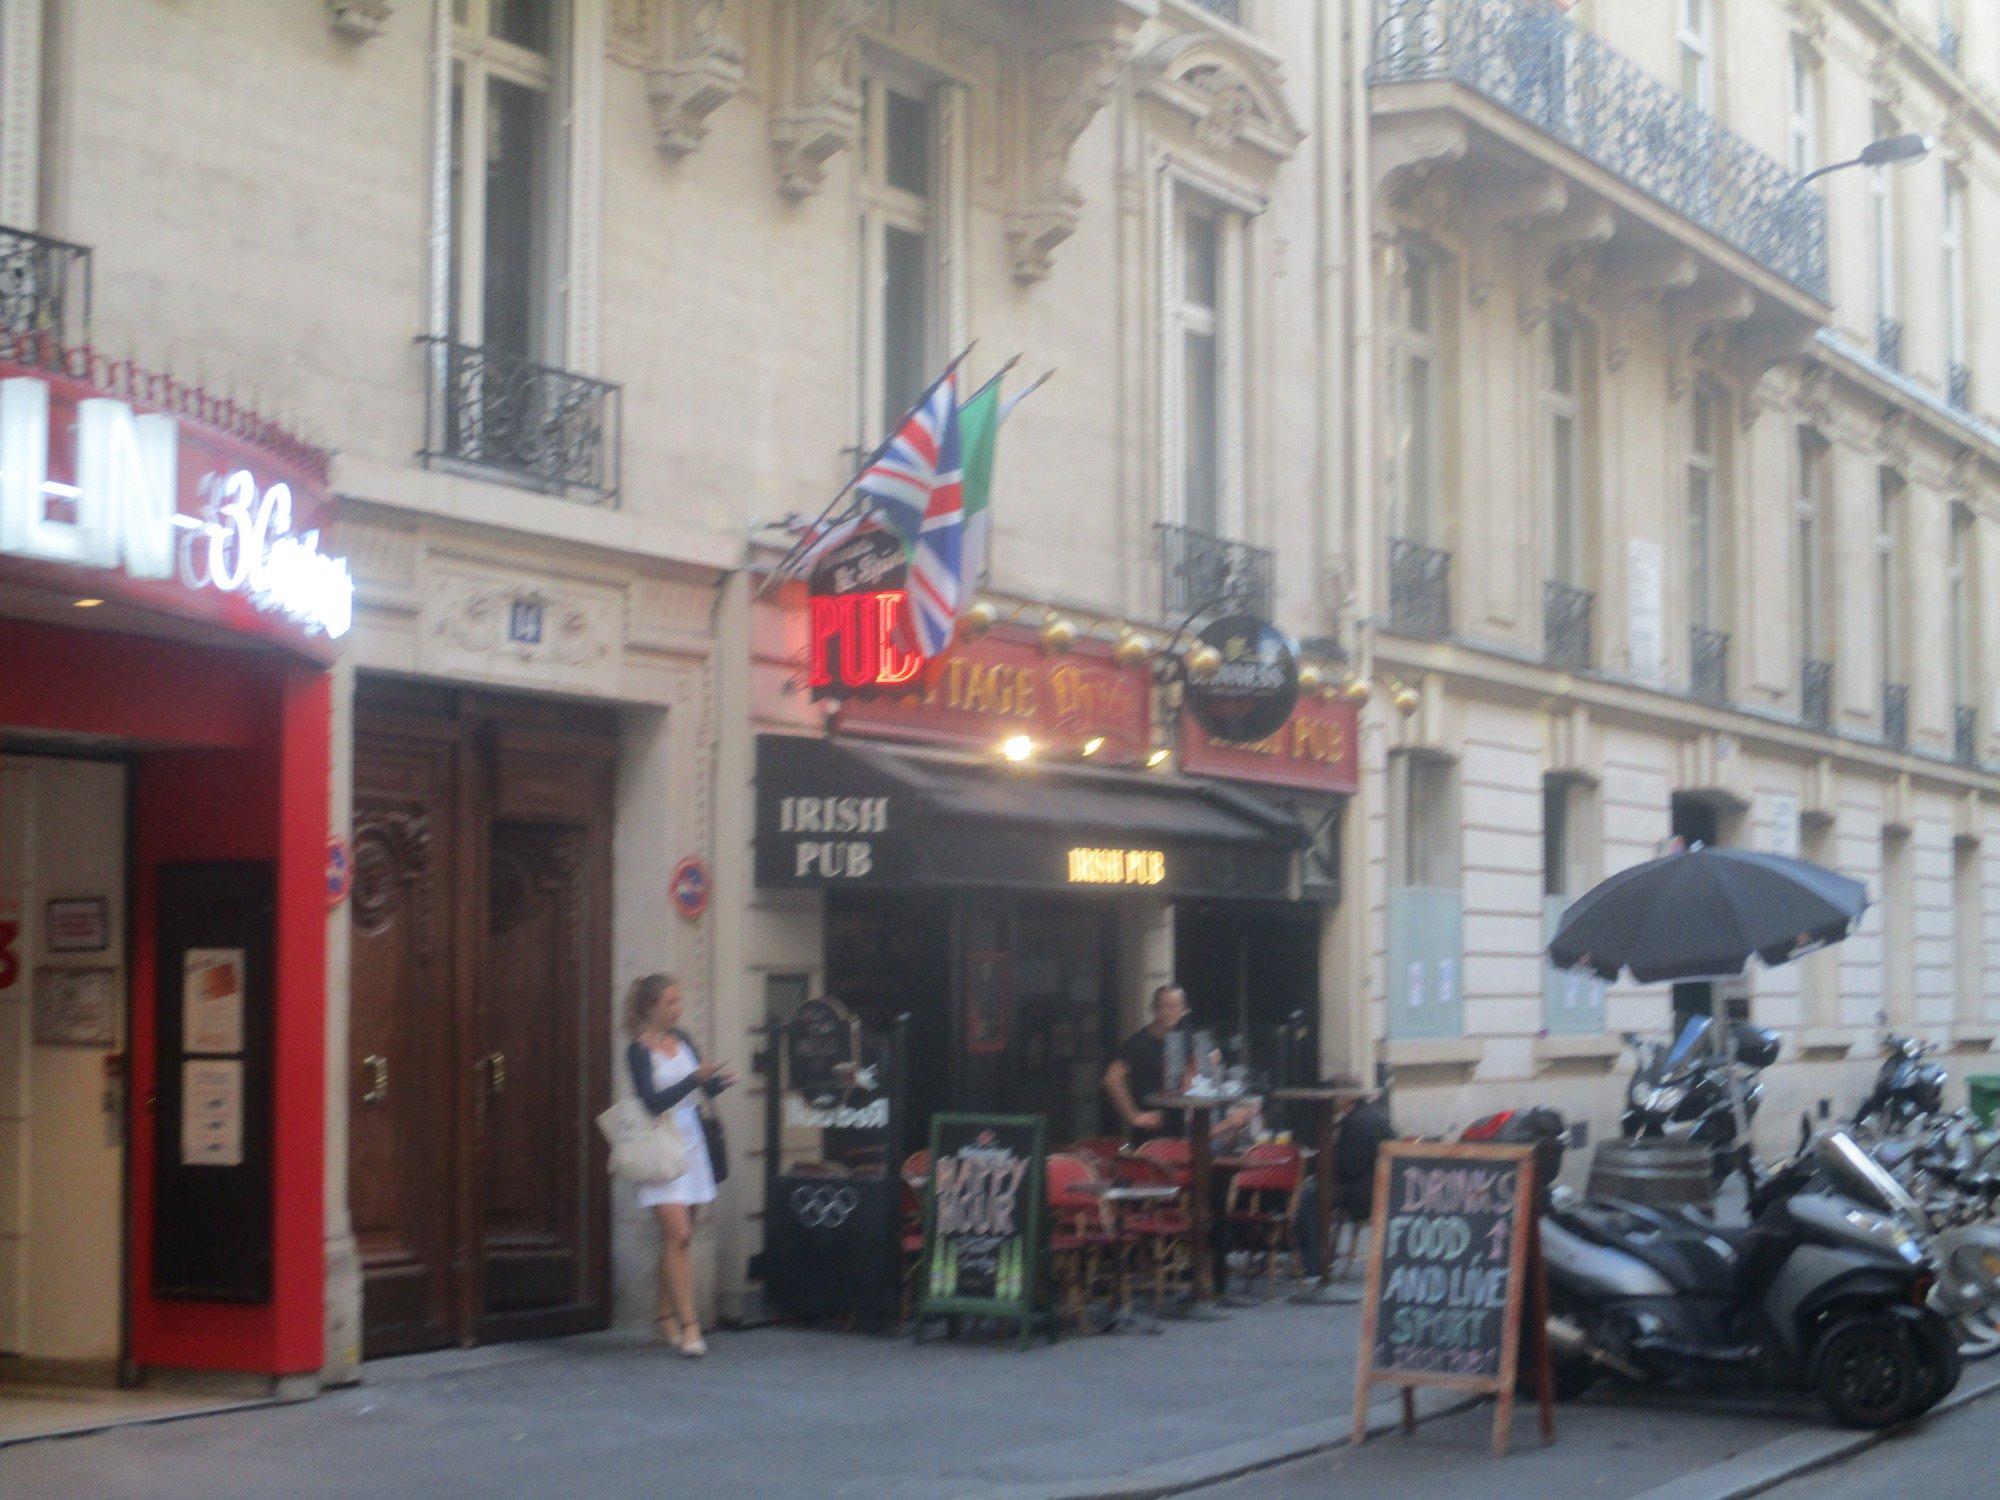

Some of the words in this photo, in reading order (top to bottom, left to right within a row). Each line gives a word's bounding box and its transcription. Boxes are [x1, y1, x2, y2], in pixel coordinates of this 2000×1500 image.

[924, 656, 1037, 718] TAGE
[780, 797, 889, 834] IRISH
[795, 841, 874, 878] PUB
[1067, 848, 1124, 884] IRISH
[1125, 849, 1165, 885] PUB
[1401, 1166, 1516, 1213] DRINKS
[1386, 1215, 1472, 1260] FOOD
[1384, 1264, 1448, 1304] AND
[1389, 1306, 1489, 1346] SPORT
